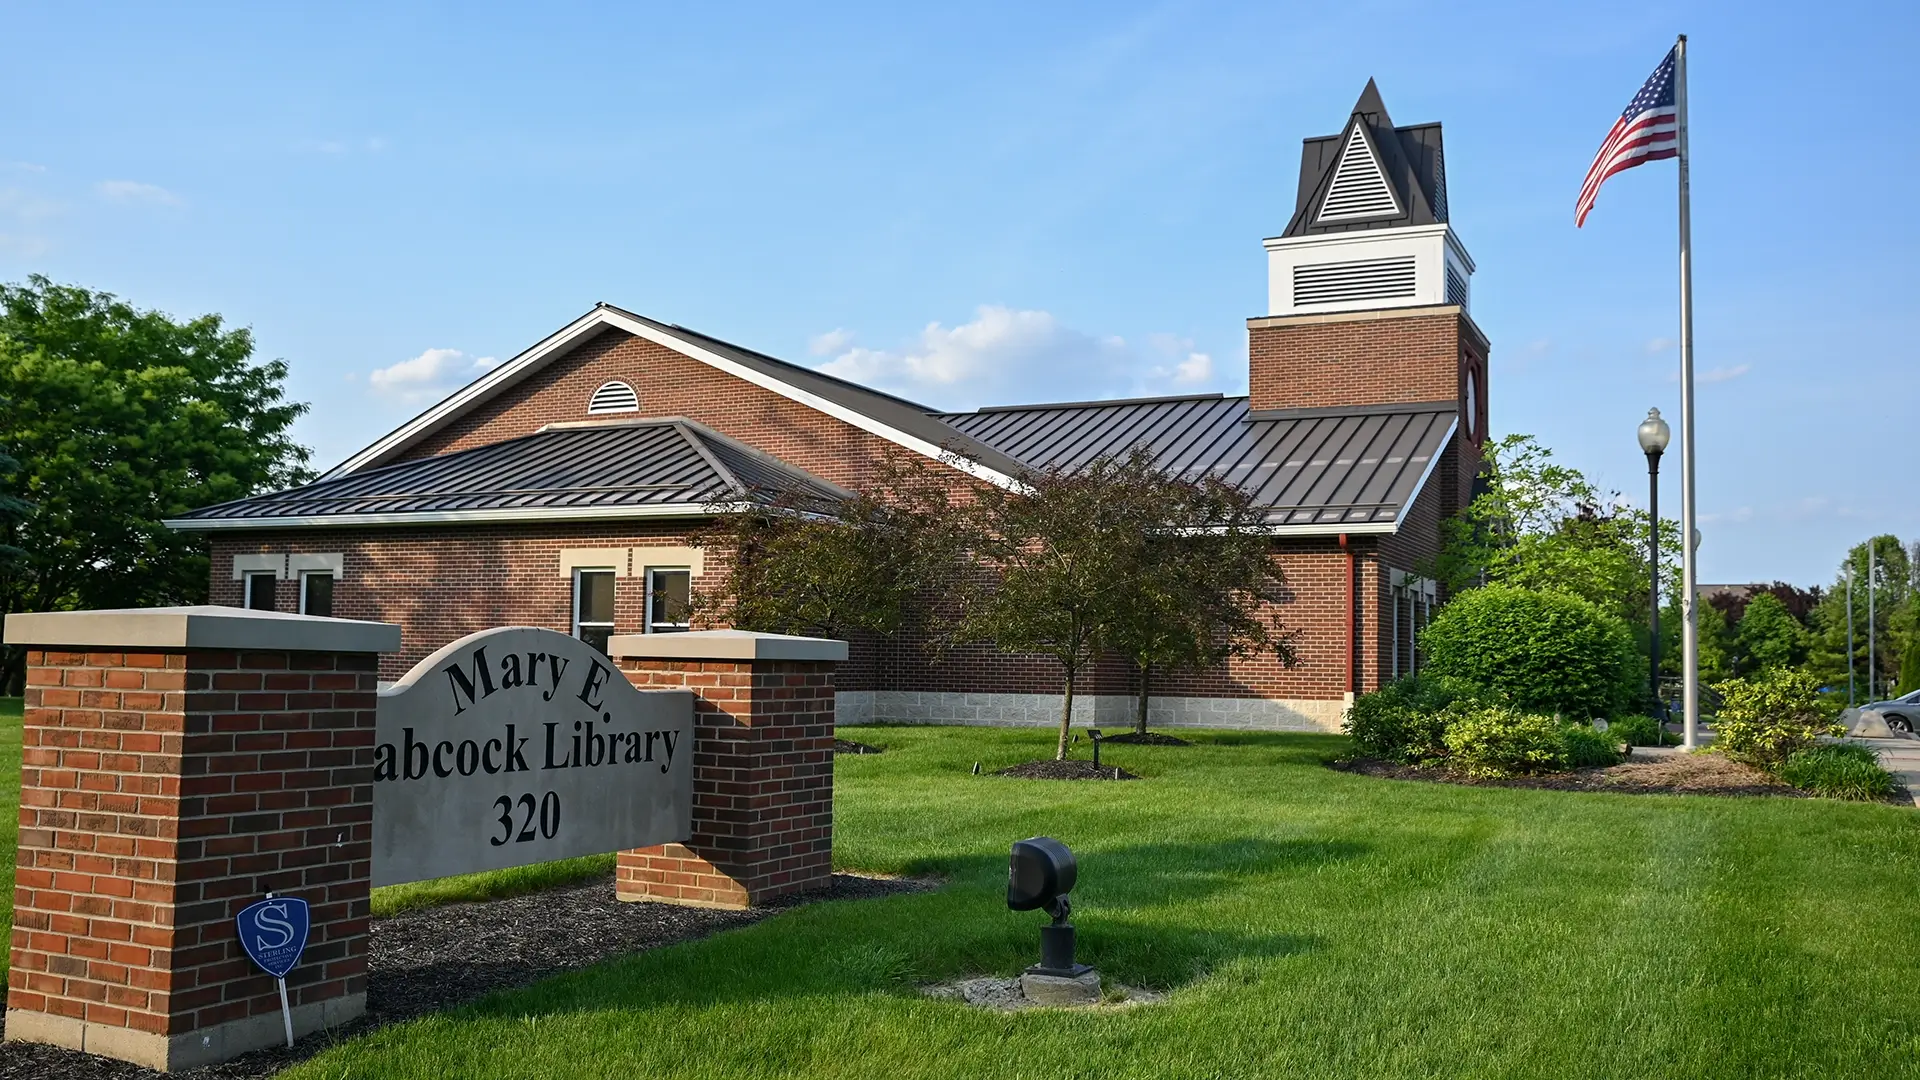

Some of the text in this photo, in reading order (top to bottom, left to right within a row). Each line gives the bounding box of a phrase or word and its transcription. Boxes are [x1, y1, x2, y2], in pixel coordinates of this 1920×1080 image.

[442, 644, 612, 723] Mary E.
[373, 721, 680, 782] abcock Library
[490, 791, 561, 847] 320
[254, 903, 294, 951] S
[258, 945, 297, 959] STERLING
